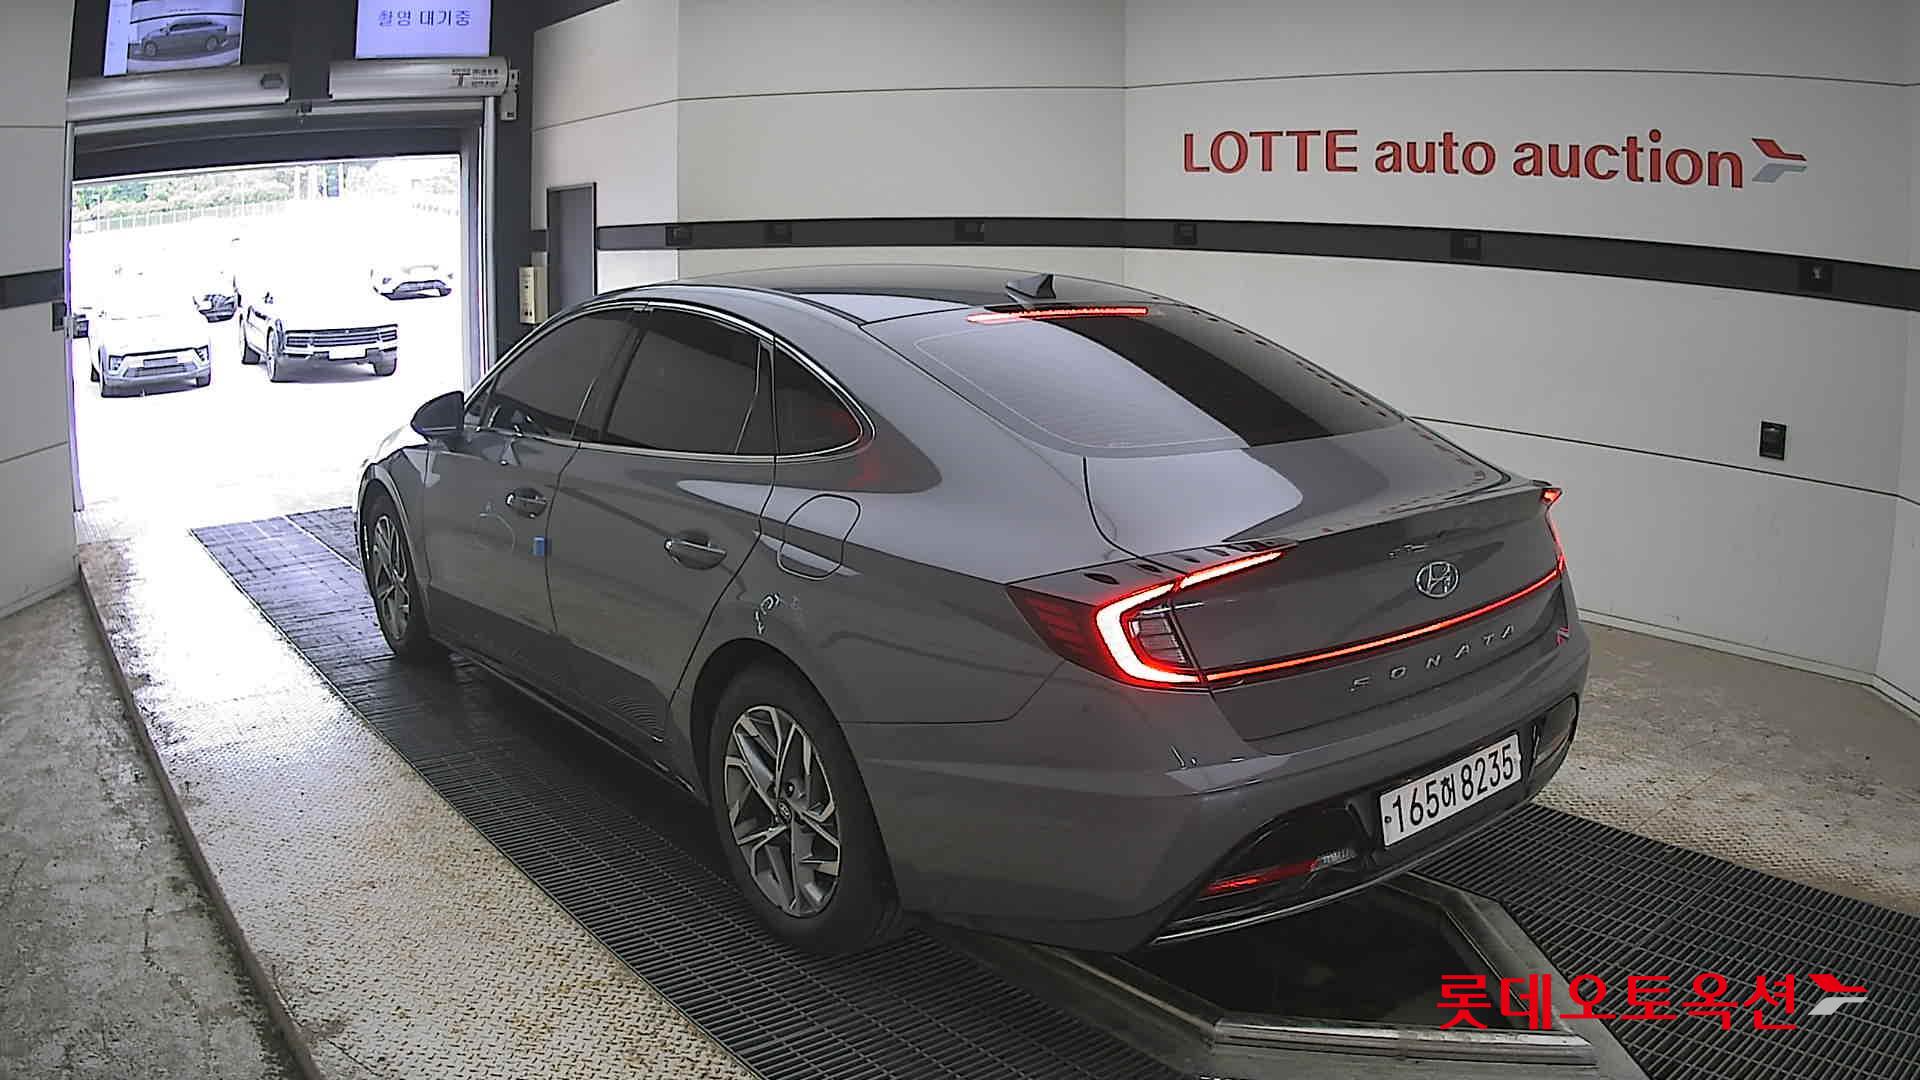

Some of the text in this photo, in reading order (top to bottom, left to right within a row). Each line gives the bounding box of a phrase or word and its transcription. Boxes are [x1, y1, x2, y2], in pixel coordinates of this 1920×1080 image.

[419, 9, 471, 27] 대기중
[1183, 129, 1745, 188] LOTTE auto auction
